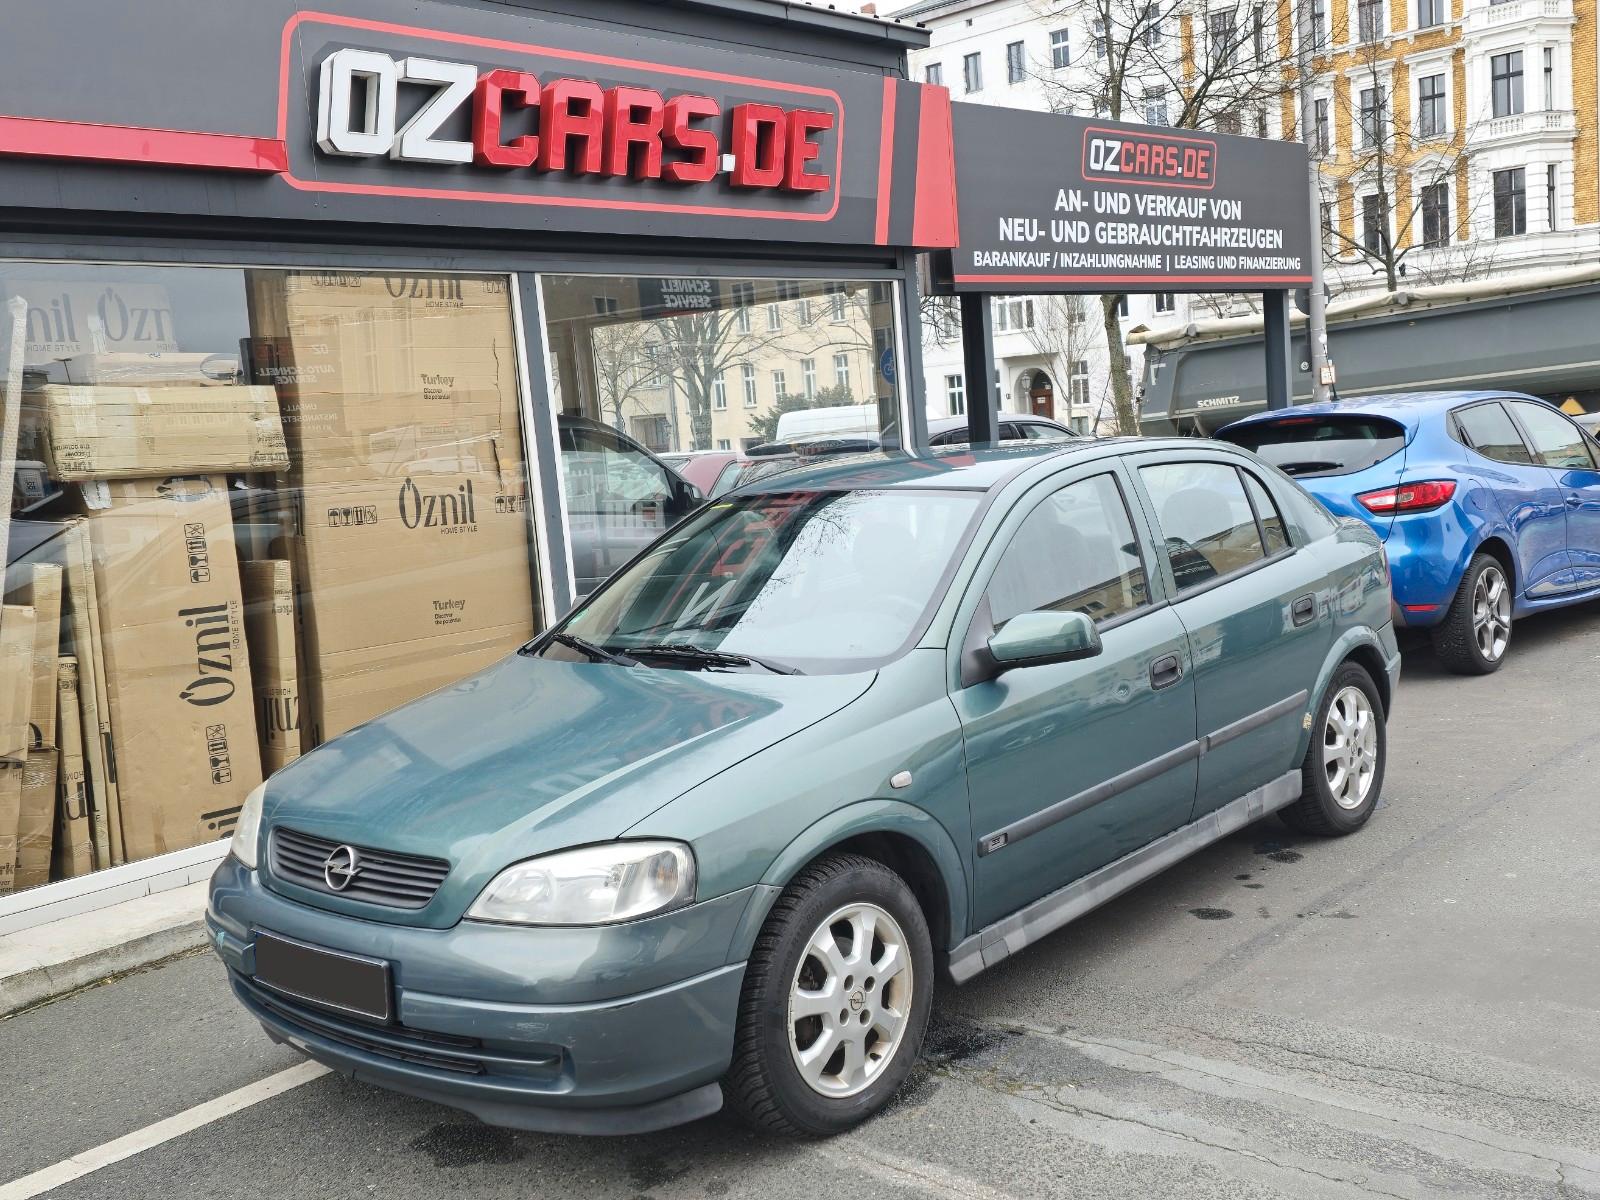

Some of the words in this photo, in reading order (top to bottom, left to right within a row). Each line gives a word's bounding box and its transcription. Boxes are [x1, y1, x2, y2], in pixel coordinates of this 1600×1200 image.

[317, 47, 834, 193] OZCARS.DE
[1090, 138, 1210, 179] OZCARS.DE
[1055, 188, 1089, 213] AN-
[1094, 191, 1130, 215] UND
[1135, 194, 1207, 219] VERKAUF
[1210, 199, 1242, 221] VON
[999, 217, 1046, 242] NEU-
[1051, 220, 1090, 243] UND
[1095, 221, 1283, 249] GEBRAUCHTFAHRZEUGEN
[973, 251, 1051, 268] BARANKAUF
[1060, 253, 1162, 269] INZAHLUNGNAHME
[1174, 255, 1215, 269] LEASING
[1217, 256, 1237, 270] UND
[1239, 257, 1301, 270] FINANZIERUNG
[421, 373, 454, 387] Turkey
[1197, 395, 1240, 408] SCHMITZ
[440, 527, 458, 535] HOME
[460, 525, 478, 533] STYLE
[432, 599, 466, 610] Turkey
[232, 627, 240, 650] HOME
